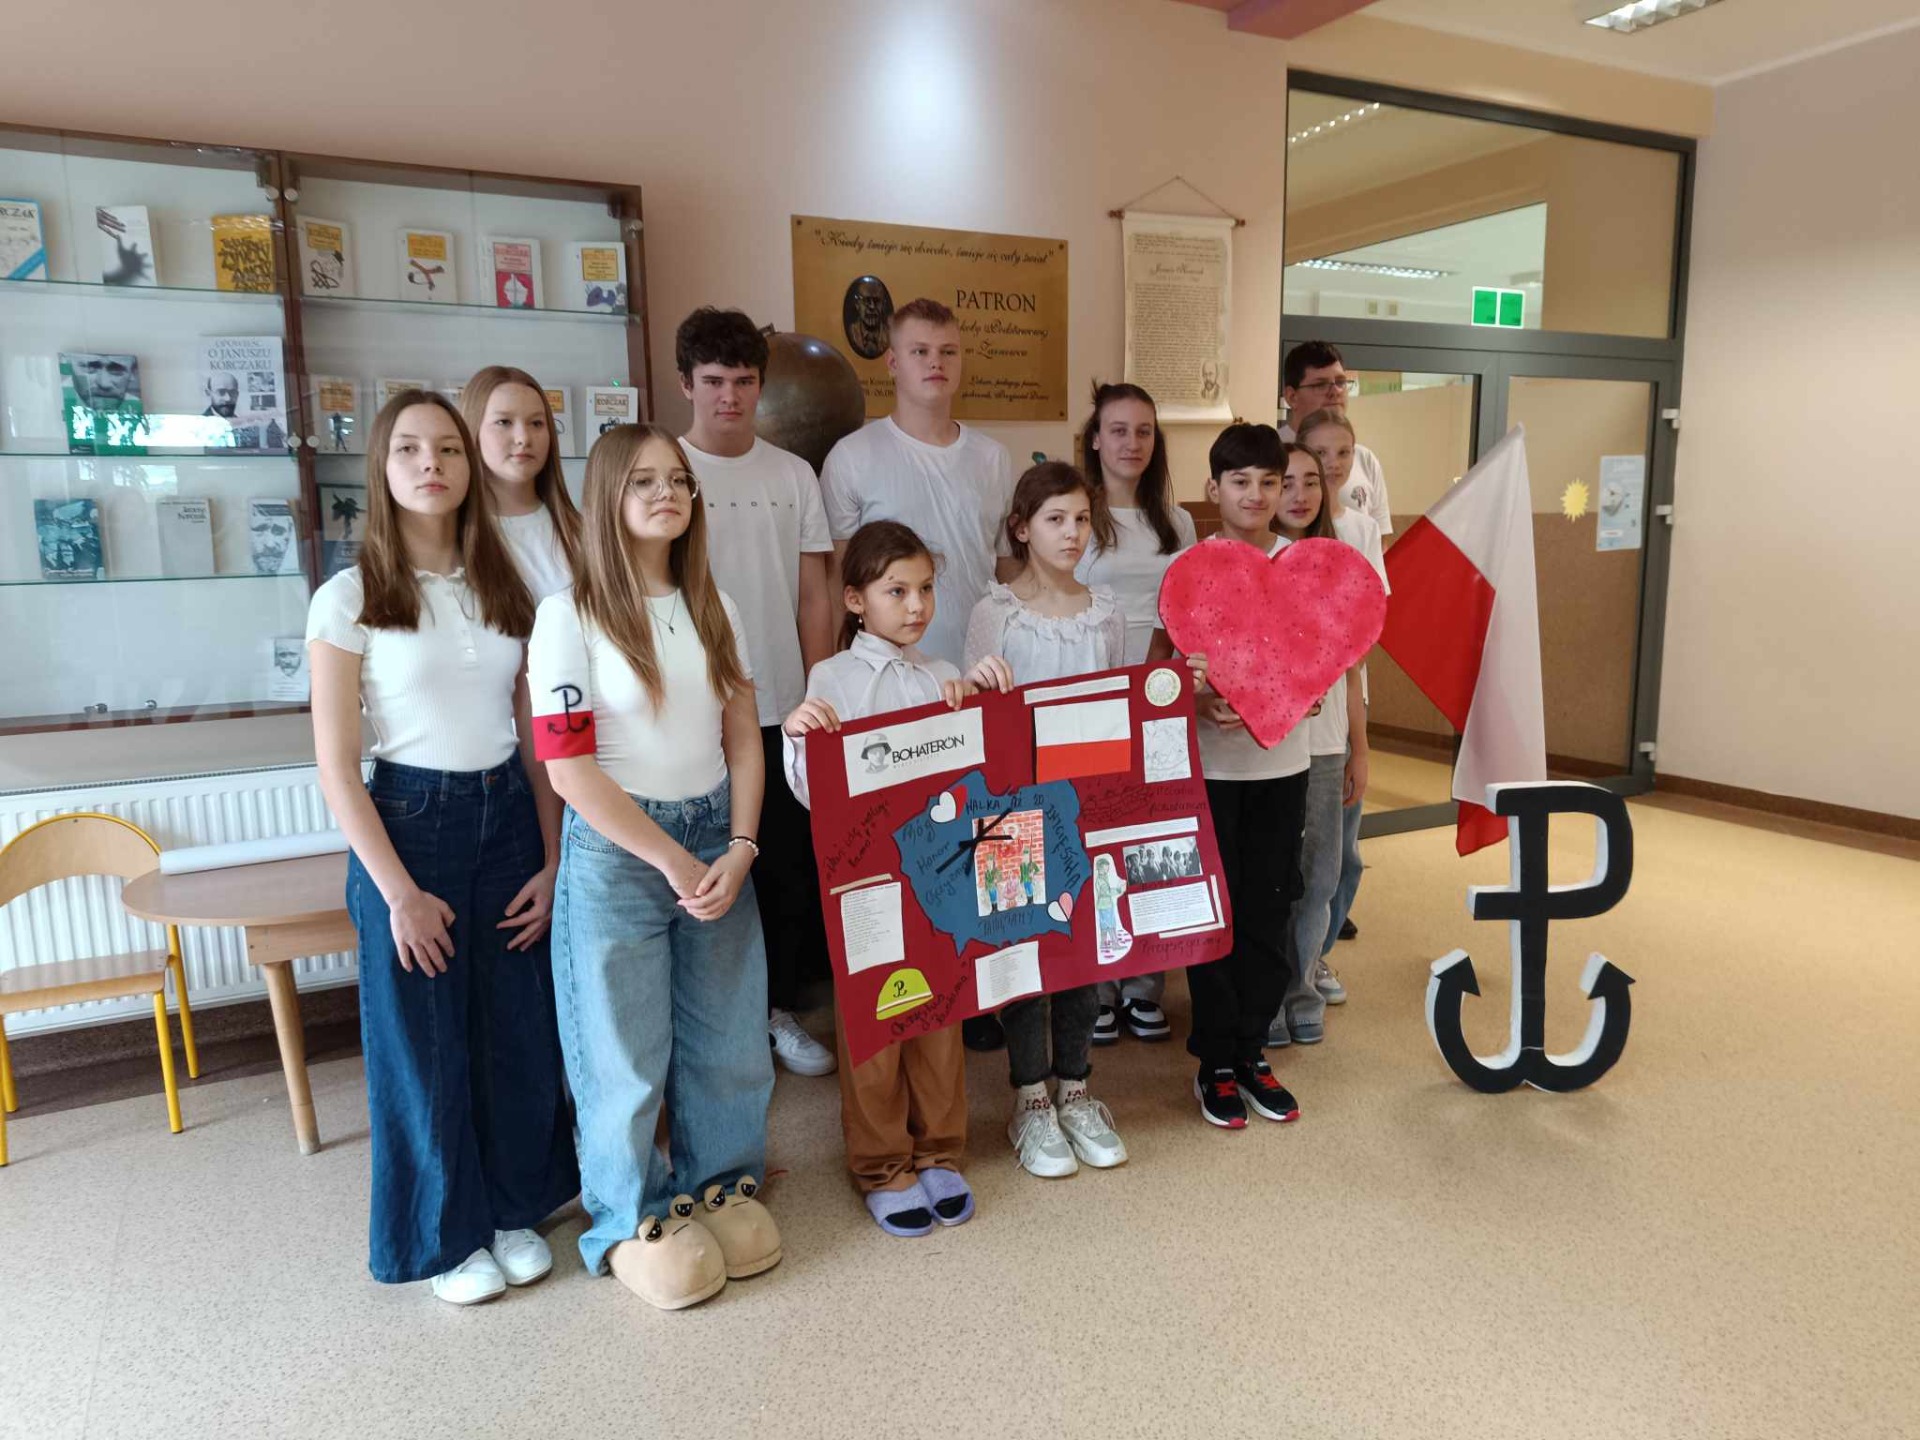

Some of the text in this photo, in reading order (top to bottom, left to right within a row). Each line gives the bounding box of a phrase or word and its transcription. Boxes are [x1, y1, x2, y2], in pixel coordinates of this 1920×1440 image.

[956, 289, 1036, 313] PATRON
[207, 348, 271, 360] O JANUSZU
[209, 359, 272, 370] KORCZAKU
